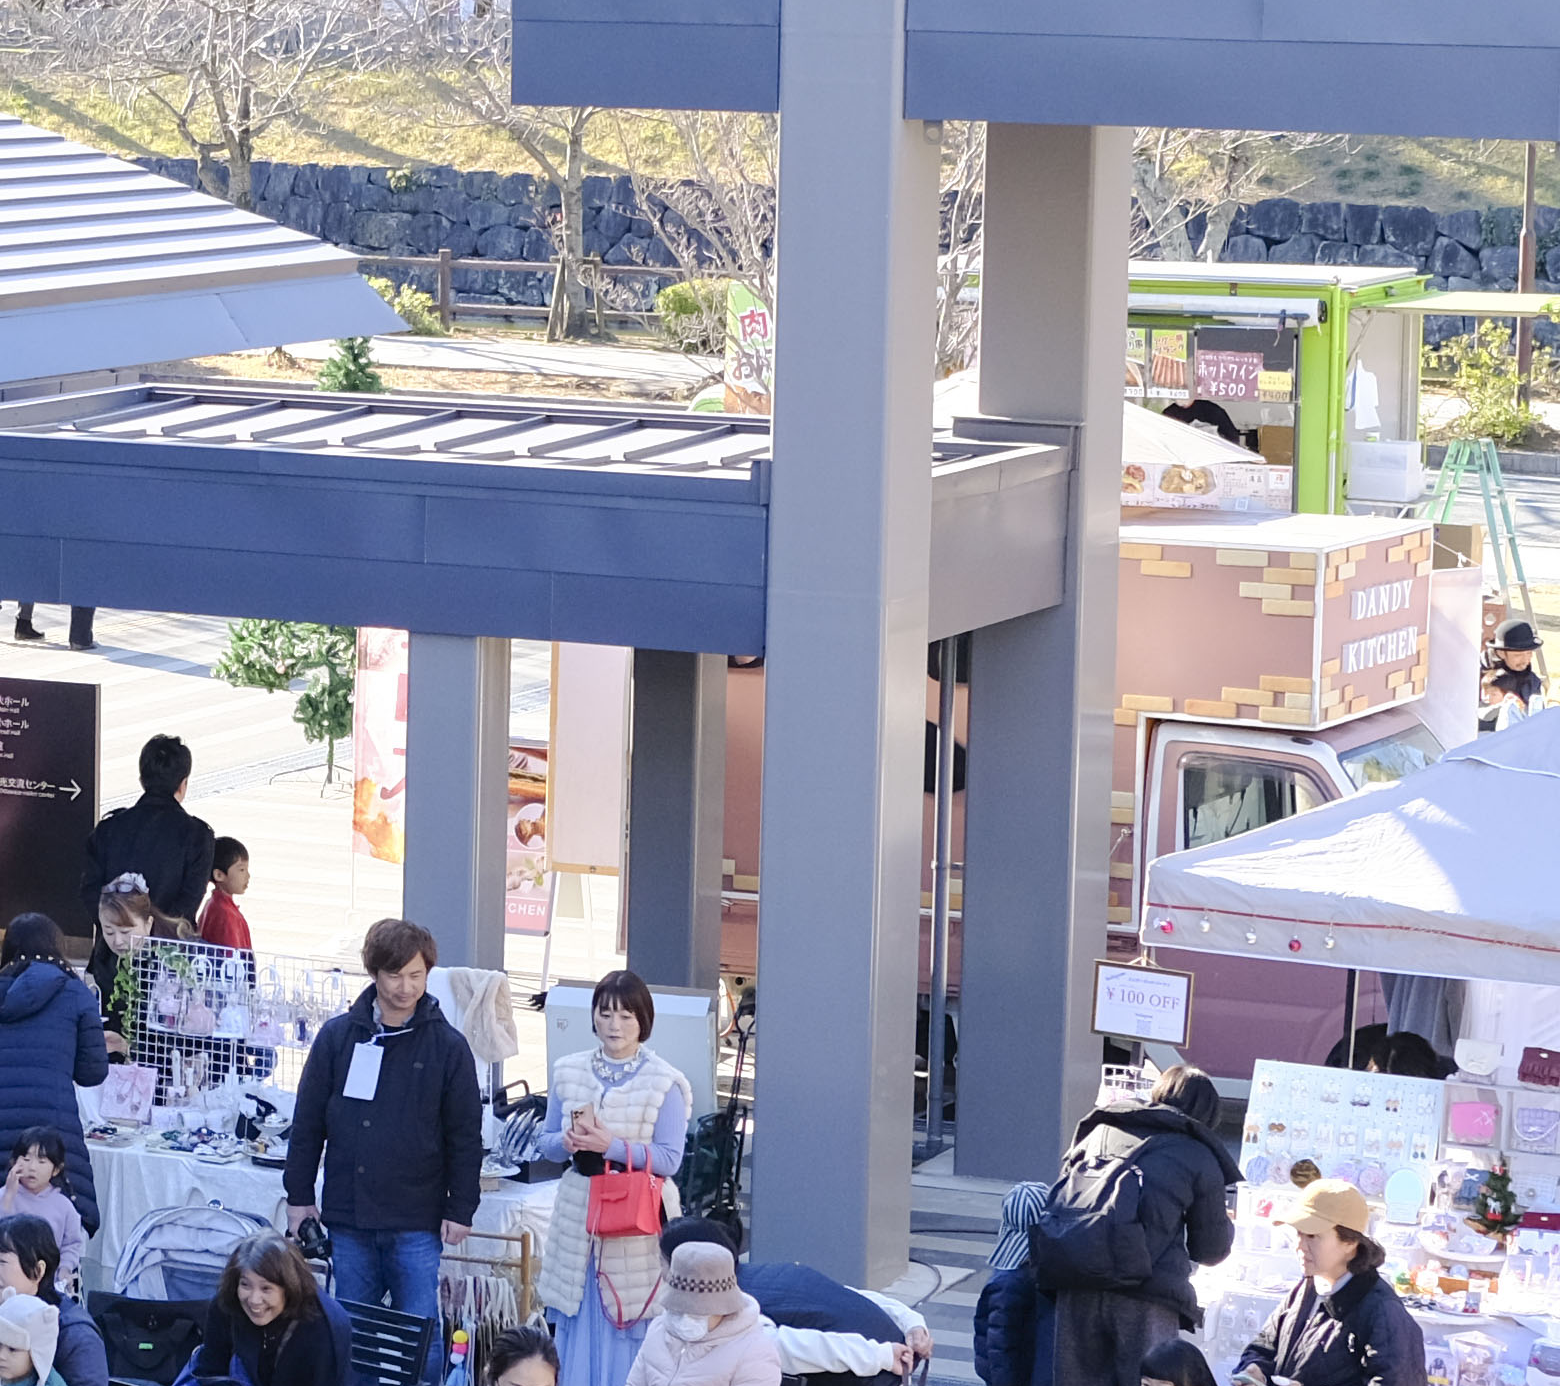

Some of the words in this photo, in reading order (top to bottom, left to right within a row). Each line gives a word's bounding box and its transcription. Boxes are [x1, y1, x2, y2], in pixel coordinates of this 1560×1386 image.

[1198, 361, 1259, 378] ホットワイン
[1209, 381, 1246, 397] ¥500
[1355, 579, 1414, 621] DANDY
[1346, 626, 1419, 674] KITCHEN
[507, 902, 546, 916] CHEN
[1149, 993, 1181, 1010] OFF
